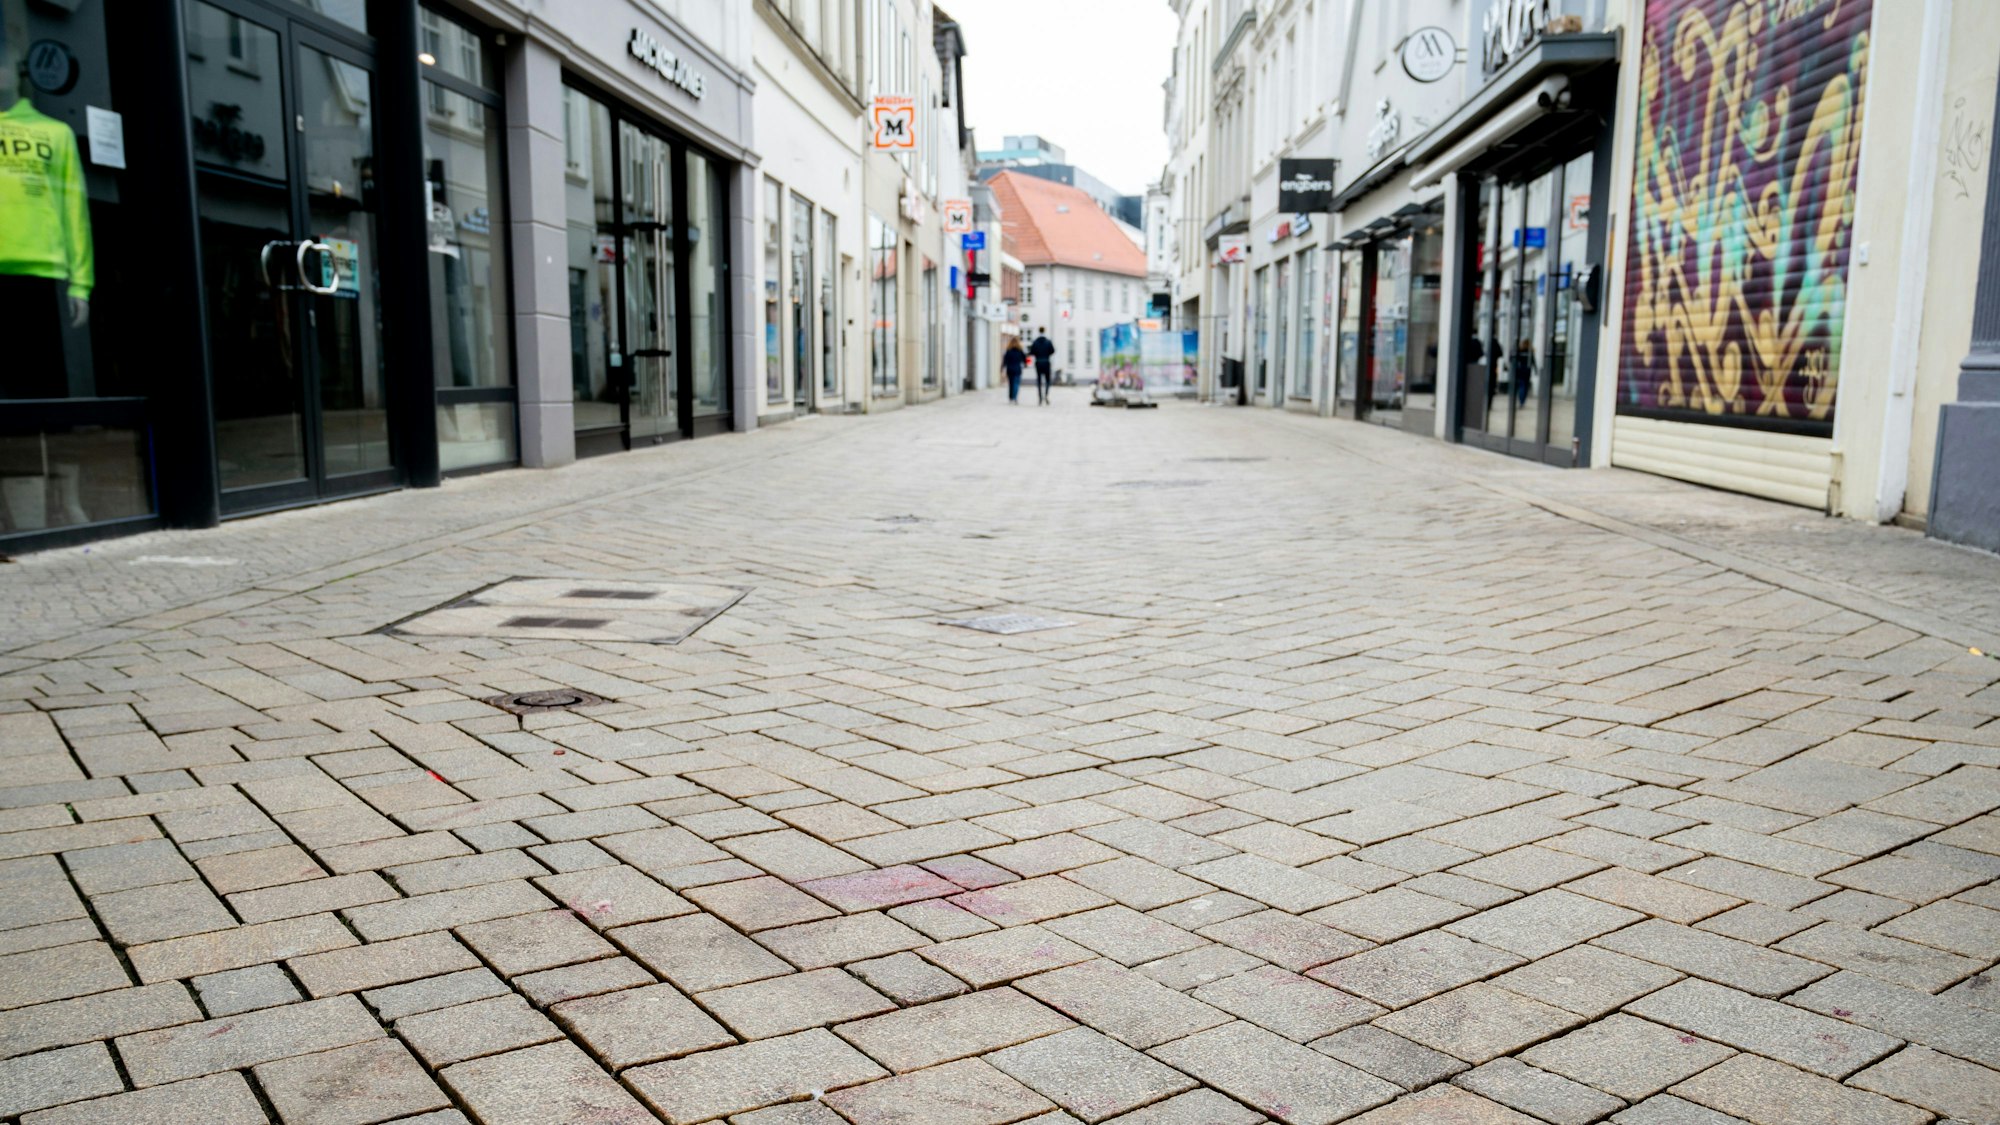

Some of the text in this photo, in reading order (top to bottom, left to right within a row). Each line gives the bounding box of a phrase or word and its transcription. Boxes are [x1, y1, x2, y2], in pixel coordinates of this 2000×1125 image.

[628, 27, 663, 73] JACK
[674, 57, 706, 99] JONES
[885, 119, 903, 136] M
[1281, 180, 1332, 193] engbers
